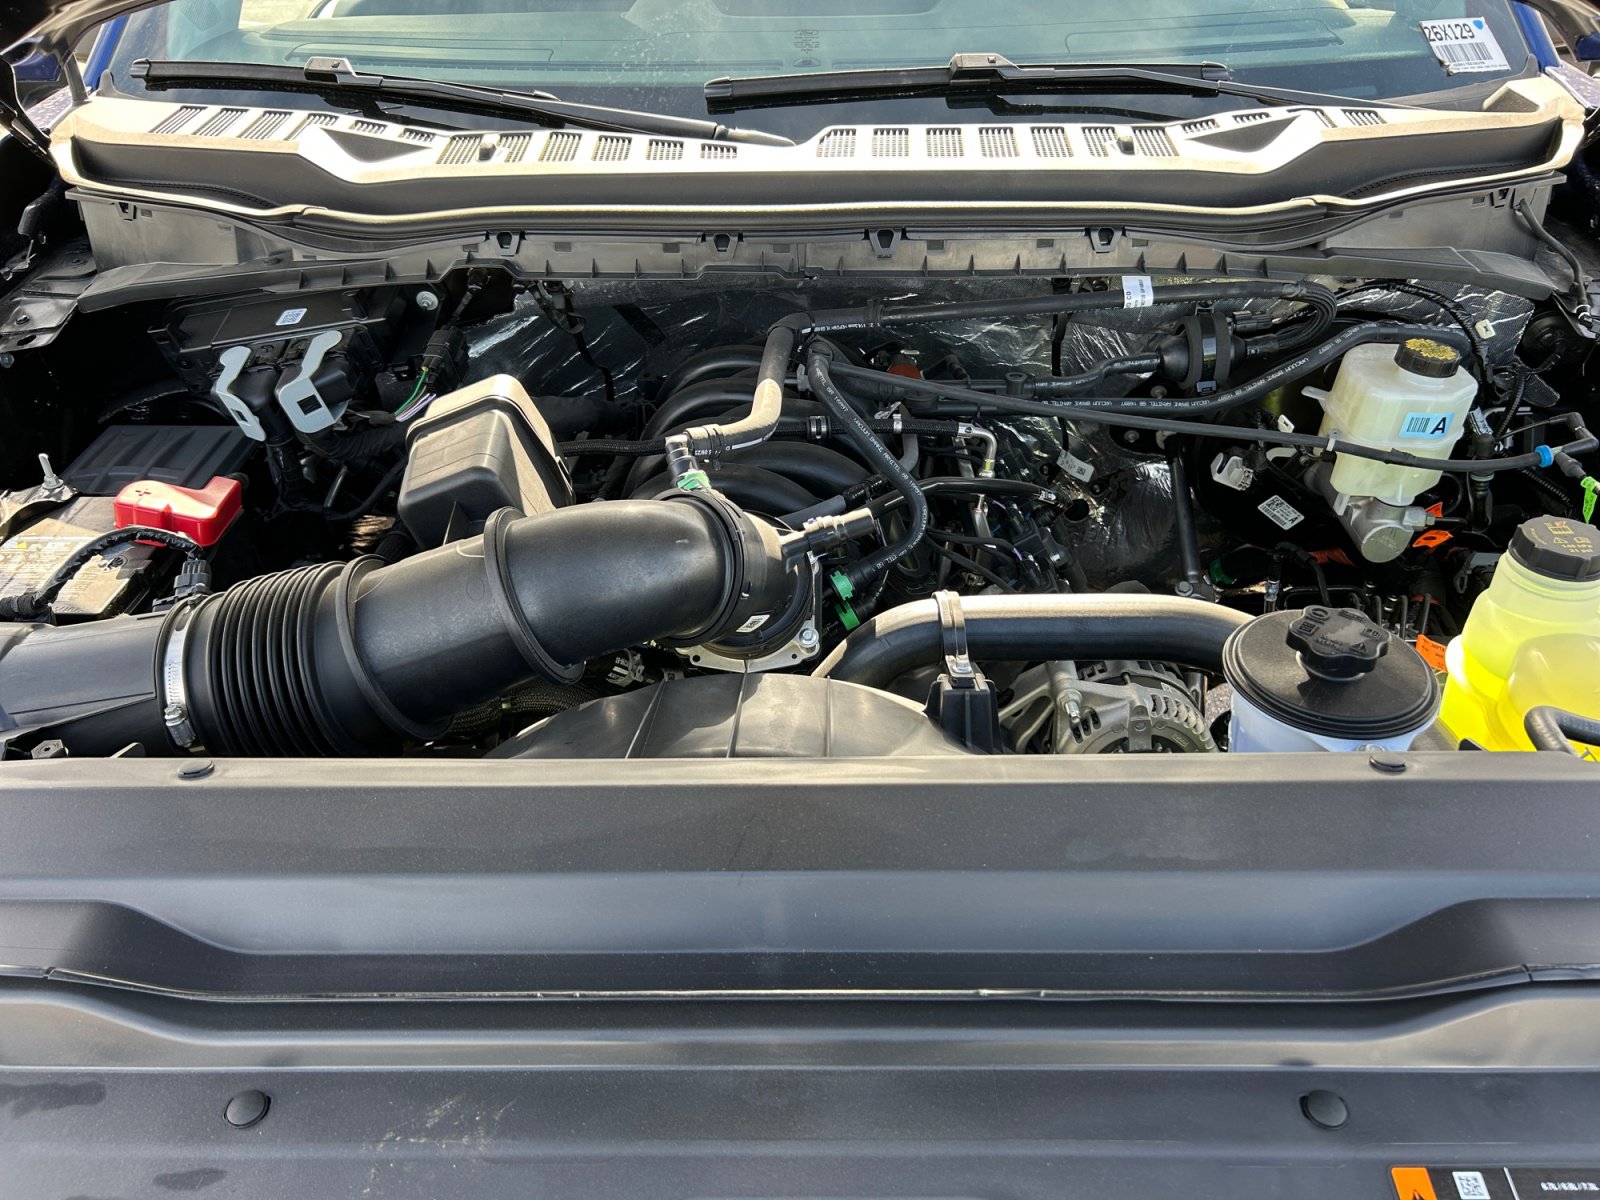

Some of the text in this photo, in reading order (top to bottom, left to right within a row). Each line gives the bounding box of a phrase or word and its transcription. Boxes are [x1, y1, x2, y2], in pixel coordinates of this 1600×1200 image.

[1424, 23, 1475, 42] 26X129
[1284, 357, 1309, 373] VACUUM
[1191, 399, 1210, 407] VACUUM
[853, 418, 870, 437] VACUUM
[1429, 416, 1447, 434] A
